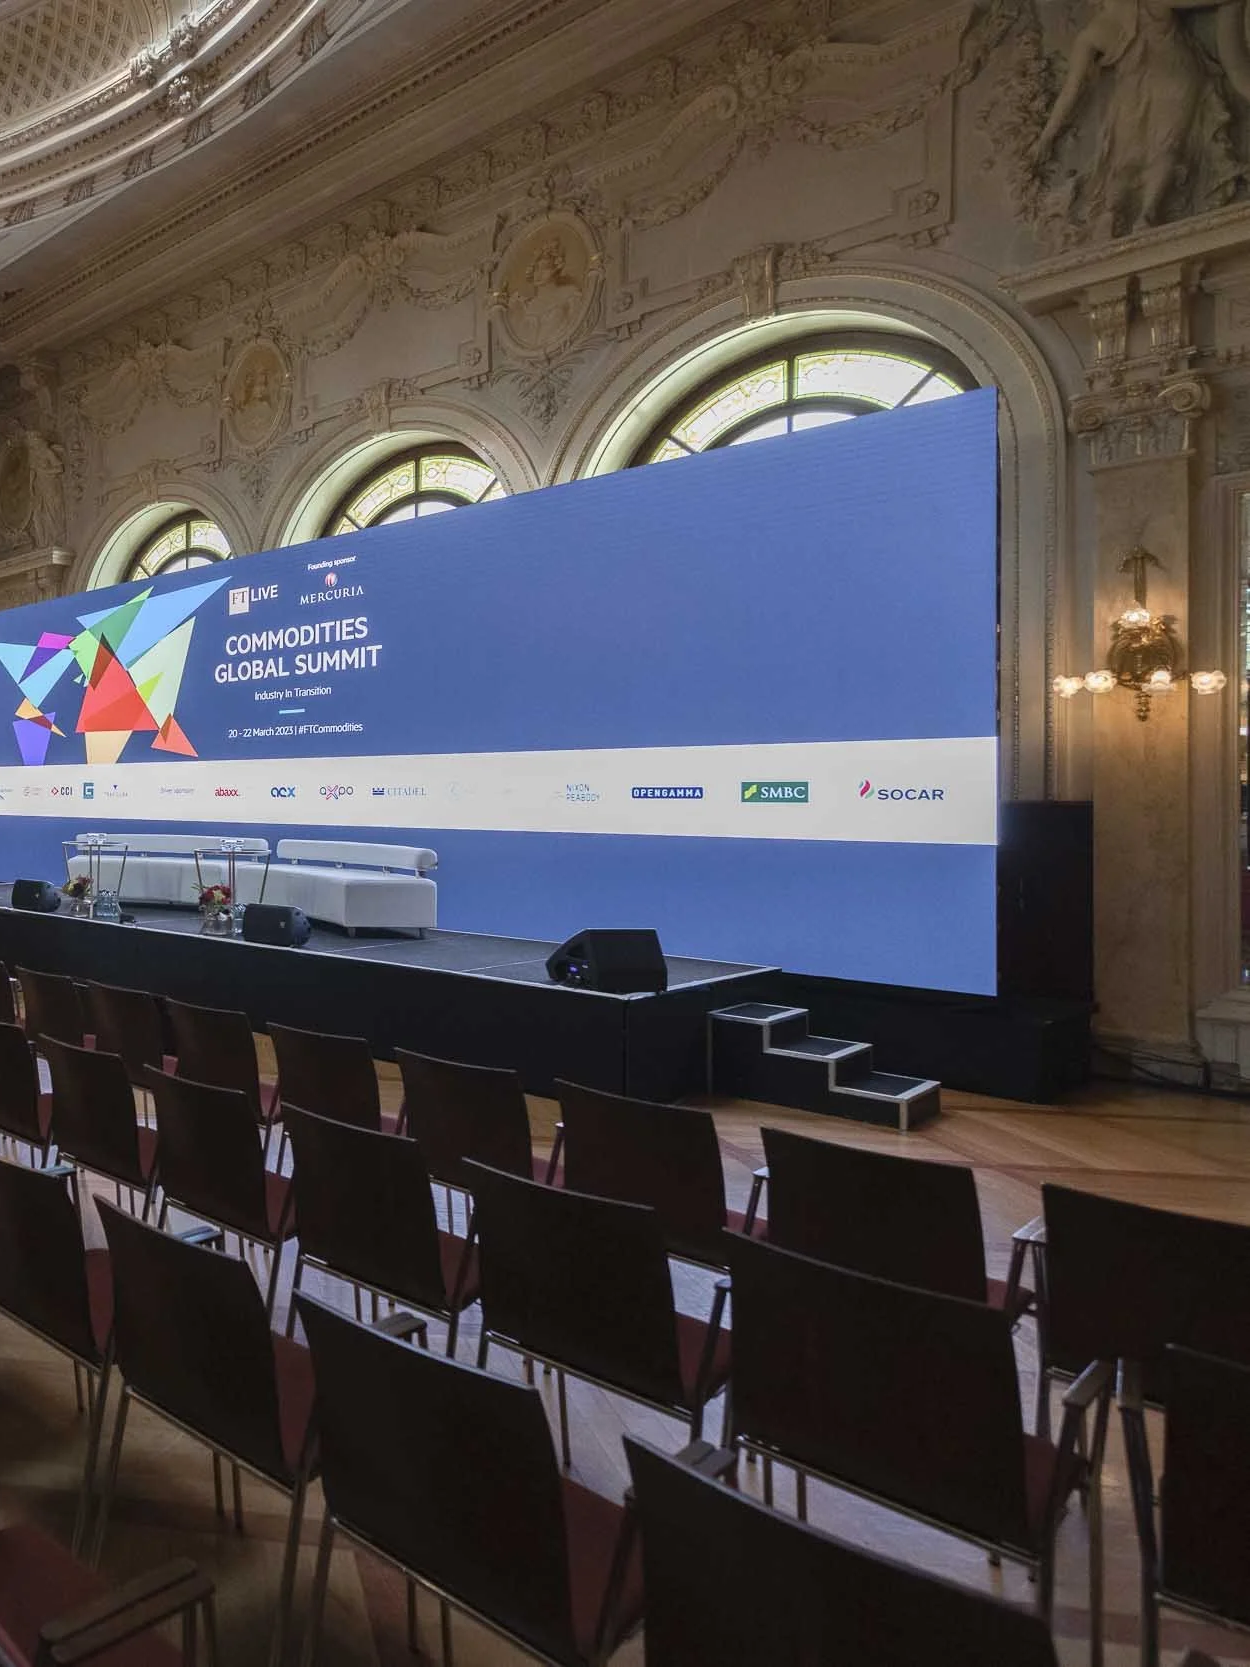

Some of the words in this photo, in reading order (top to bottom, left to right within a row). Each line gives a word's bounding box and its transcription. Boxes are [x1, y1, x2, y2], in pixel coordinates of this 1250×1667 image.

[308, 561, 333, 570] Founding
[334, 556, 356, 566] sponsor
[232, 590, 247, 605] FT
[251, 584, 278, 602] LIVE
[300, 585, 364, 605] MERCURIA
[225, 616, 368, 656] COMMODITIES
[215, 656, 290, 684] GLOBAL
[294, 644, 382, 675] SUMMIT
[254, 690, 284, 701] Industry
[285, 689, 292, 698] In
[294, 686, 332, 697] Transition
[228, 729, 238, 738] 20
[242, 728, 252, 738] 22
[252, 726, 274, 737] March
[275, 725, 294, 736] 2023
[298, 722, 363, 735] #FTCommodities
[60, 786, 73, 796] CCI
[633, 788, 702, 798] OPENGAMMA
[760, 786, 806, 799] SMBC
[877, 788, 945, 801] SOCAR
